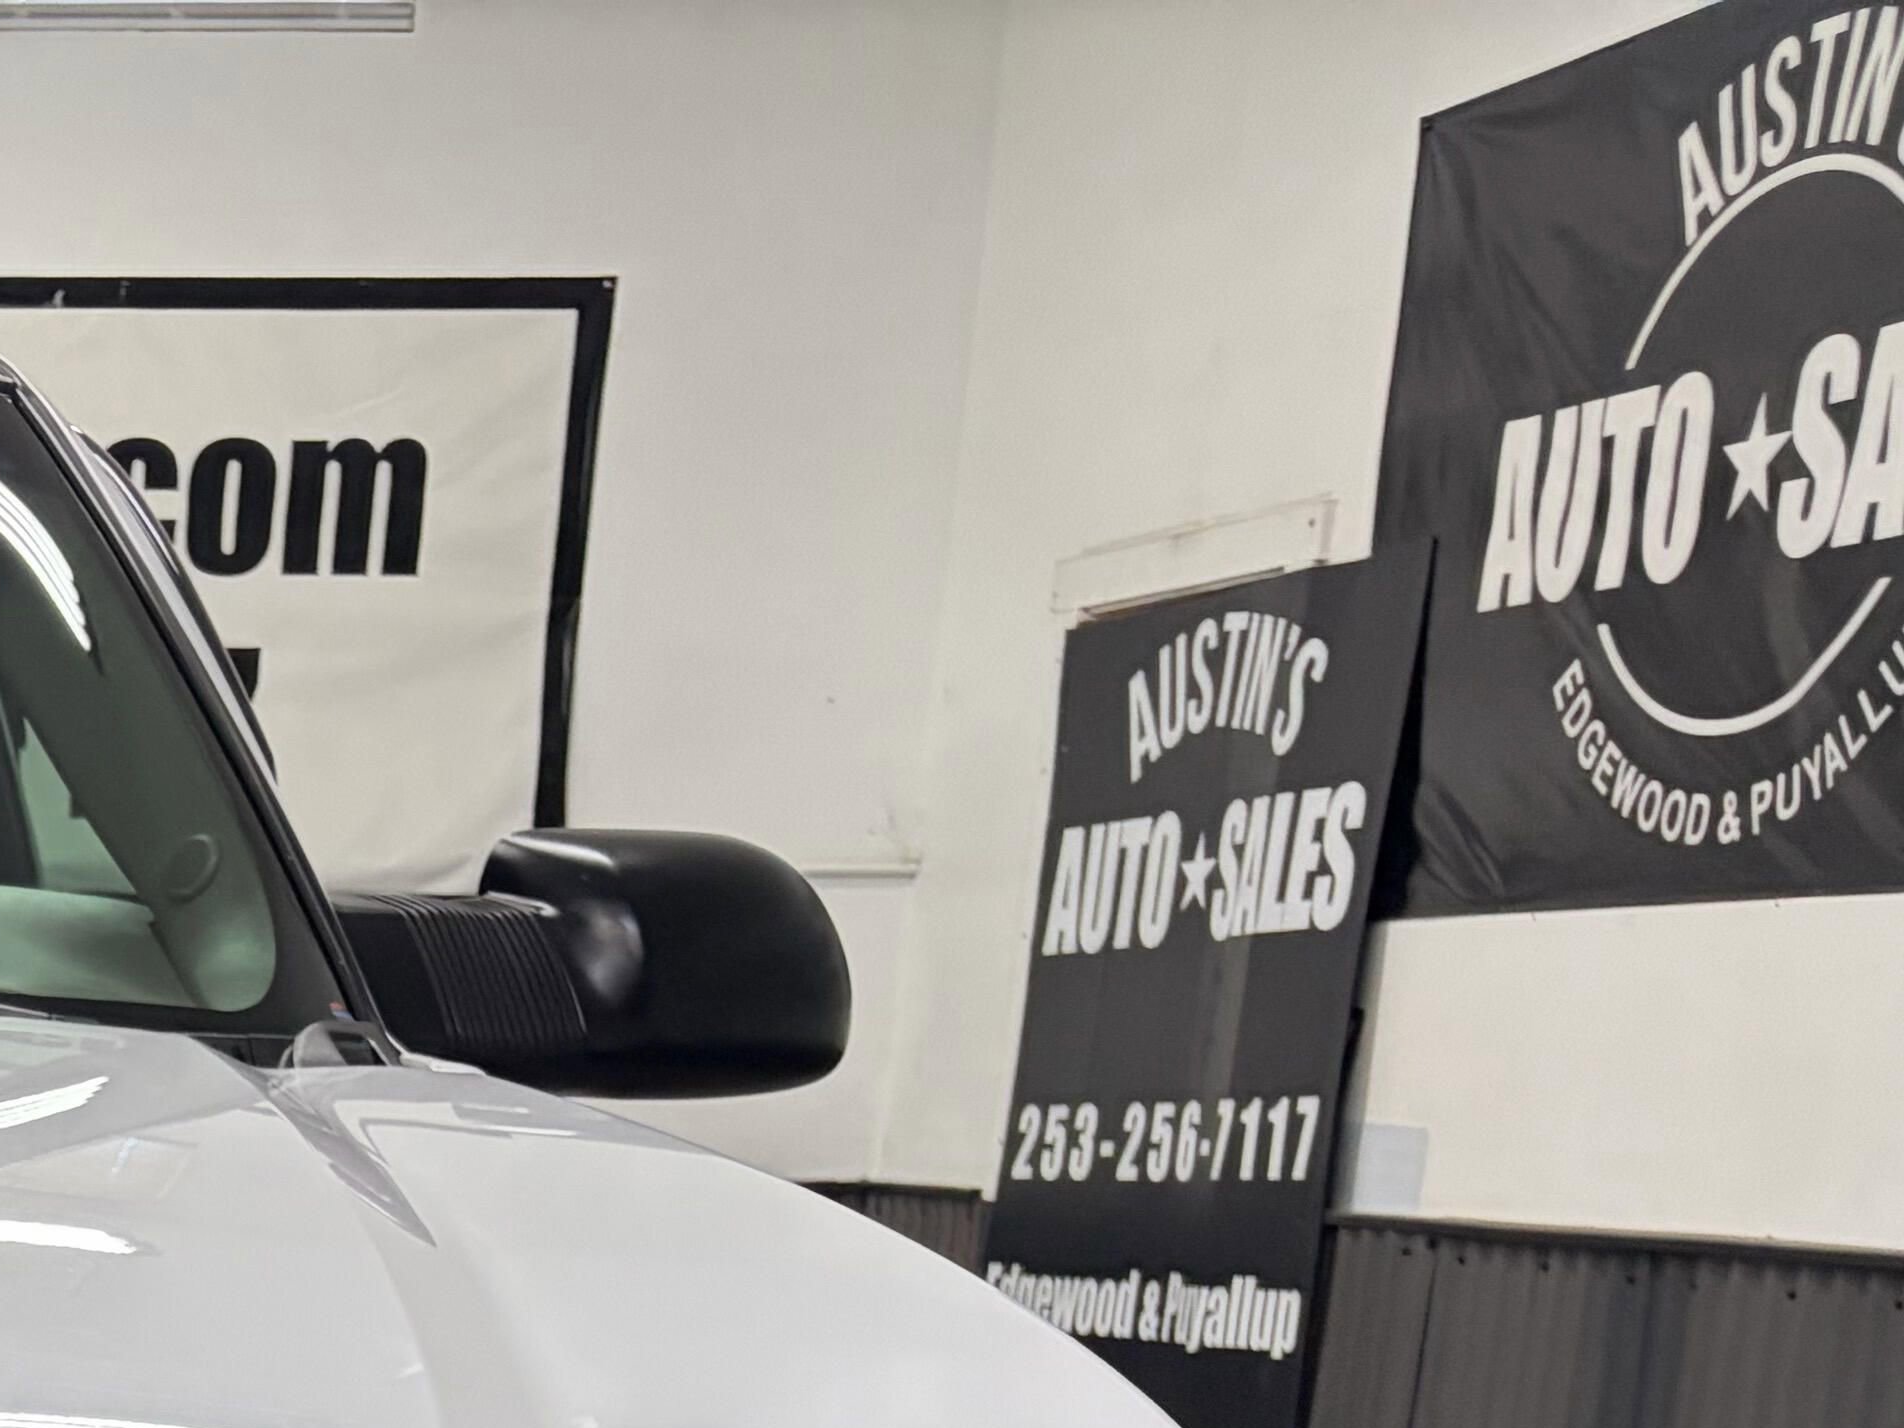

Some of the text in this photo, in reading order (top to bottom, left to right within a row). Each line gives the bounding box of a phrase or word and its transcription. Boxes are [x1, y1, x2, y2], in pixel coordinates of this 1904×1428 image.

[1678, 5, 1904, 247] AUSTIN
[1476, 370, 1715, 614] AUTO
[1127, 610, 1329, 784] AUSTIN'S
[1551, 624, 1904, 847] EDGEWOOD & PUYALLU
[1041, 780, 1367, 957] AUTO SALES
[1010, 1095, 1321, 1183] 253-256-7117
[1138, 1279, 1161, 1342] &
[1160, 1270, 1302, 1361] Puyallup
